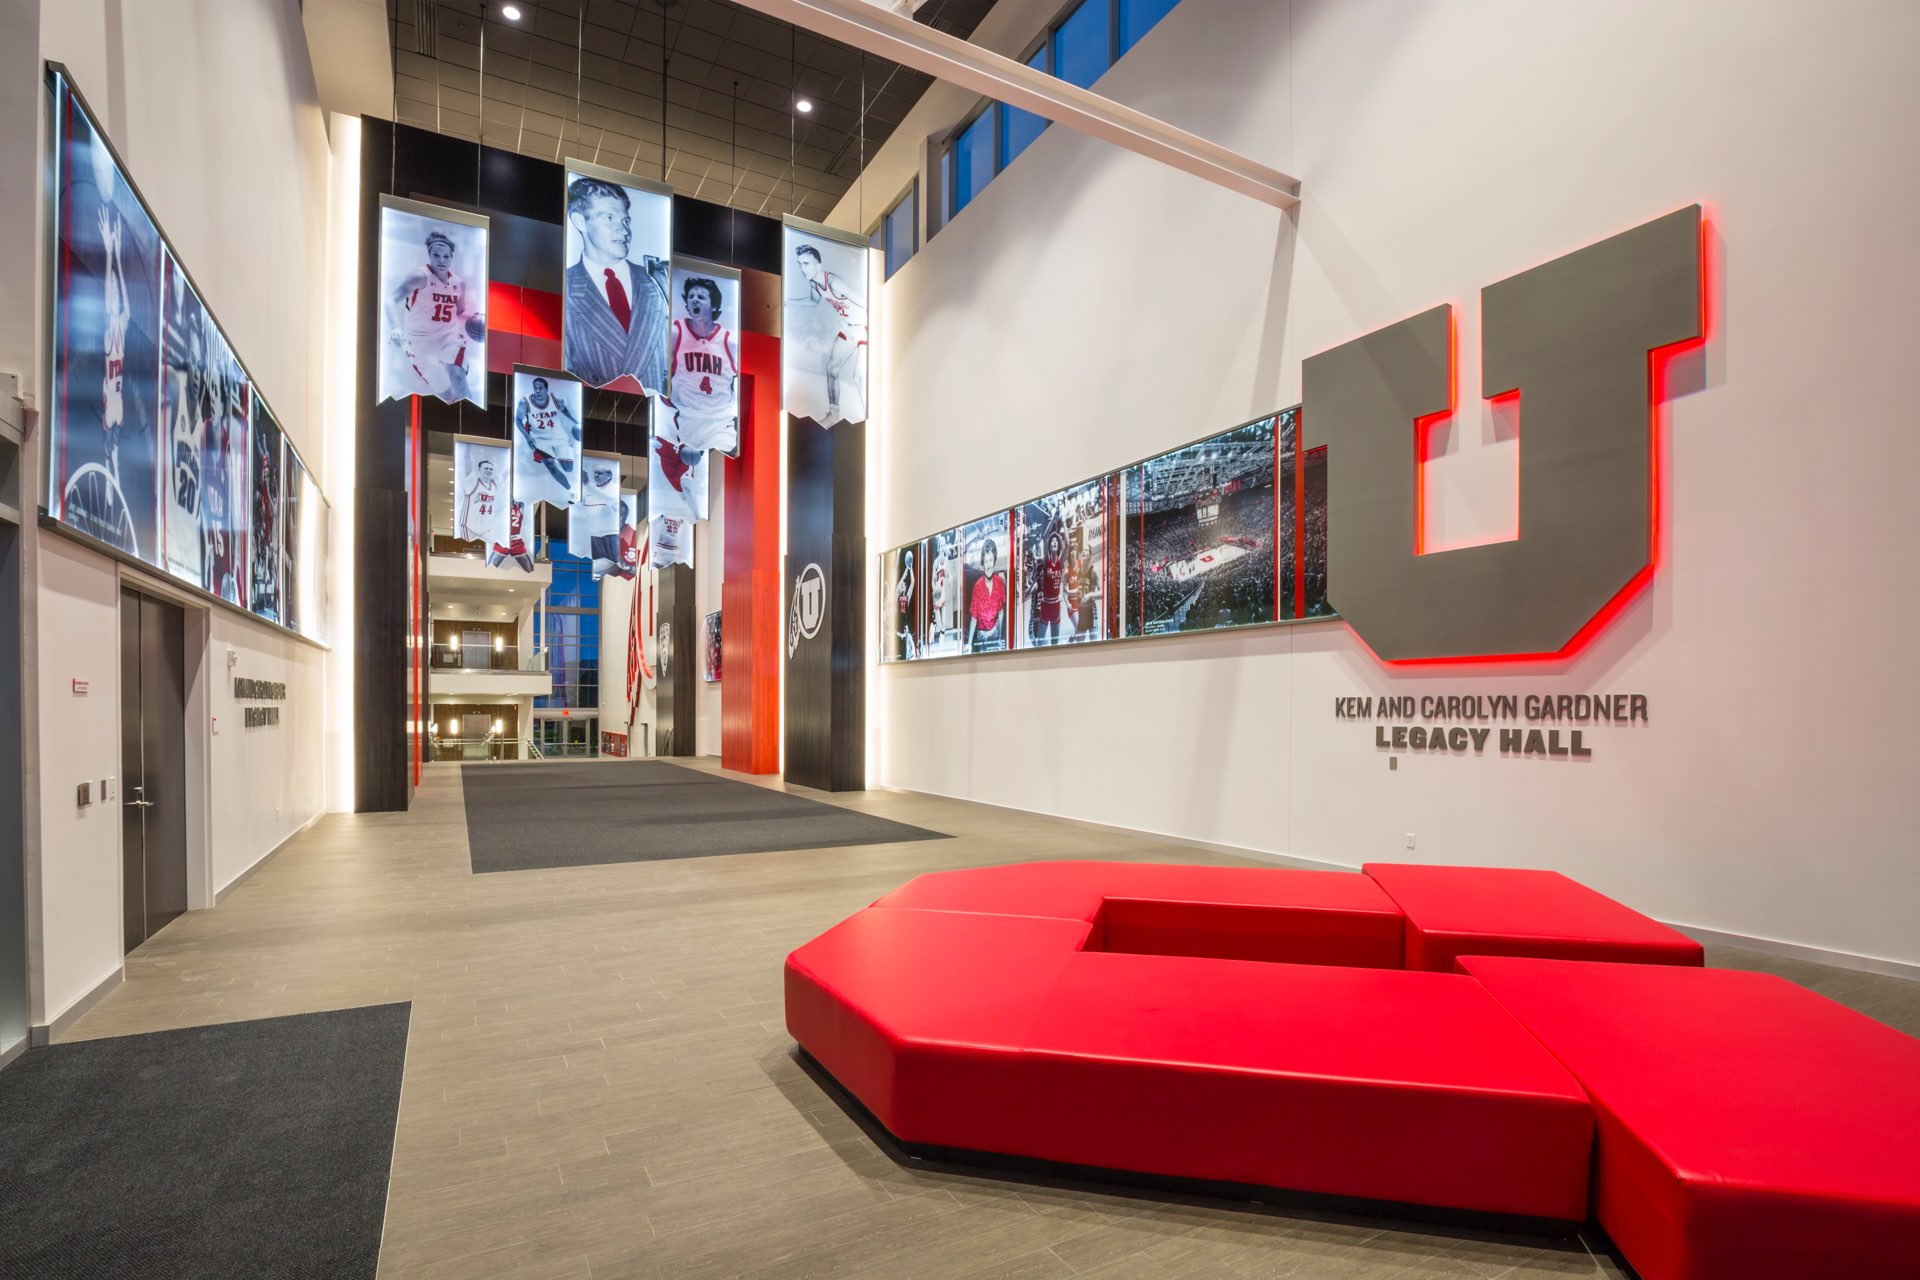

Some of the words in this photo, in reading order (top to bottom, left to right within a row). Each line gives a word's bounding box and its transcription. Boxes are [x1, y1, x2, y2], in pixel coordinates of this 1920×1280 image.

[431, 303, 452, 322] 15
[684, 352, 723, 376] UTAH
[699, 376, 713, 395] 4
[531, 411, 557, 419] UTAH
[537, 419, 555, 430] 24
[1302, 203, 1704, 664] U
[177, 468, 196, 515] 20
[479, 504, 493, 515] 44
[212, 519, 225, 557] 15
[801, 576, 820, 630] U
[1335, 697, 1372, 718] KEM
[1376, 696, 1415, 718] AND
[1420, 695, 1517, 719] CAROLYN
[1524, 694, 1648, 721] GARDNER
[1376, 726, 1490, 751] LEGACY
[1499, 728, 1592, 756] HALL
